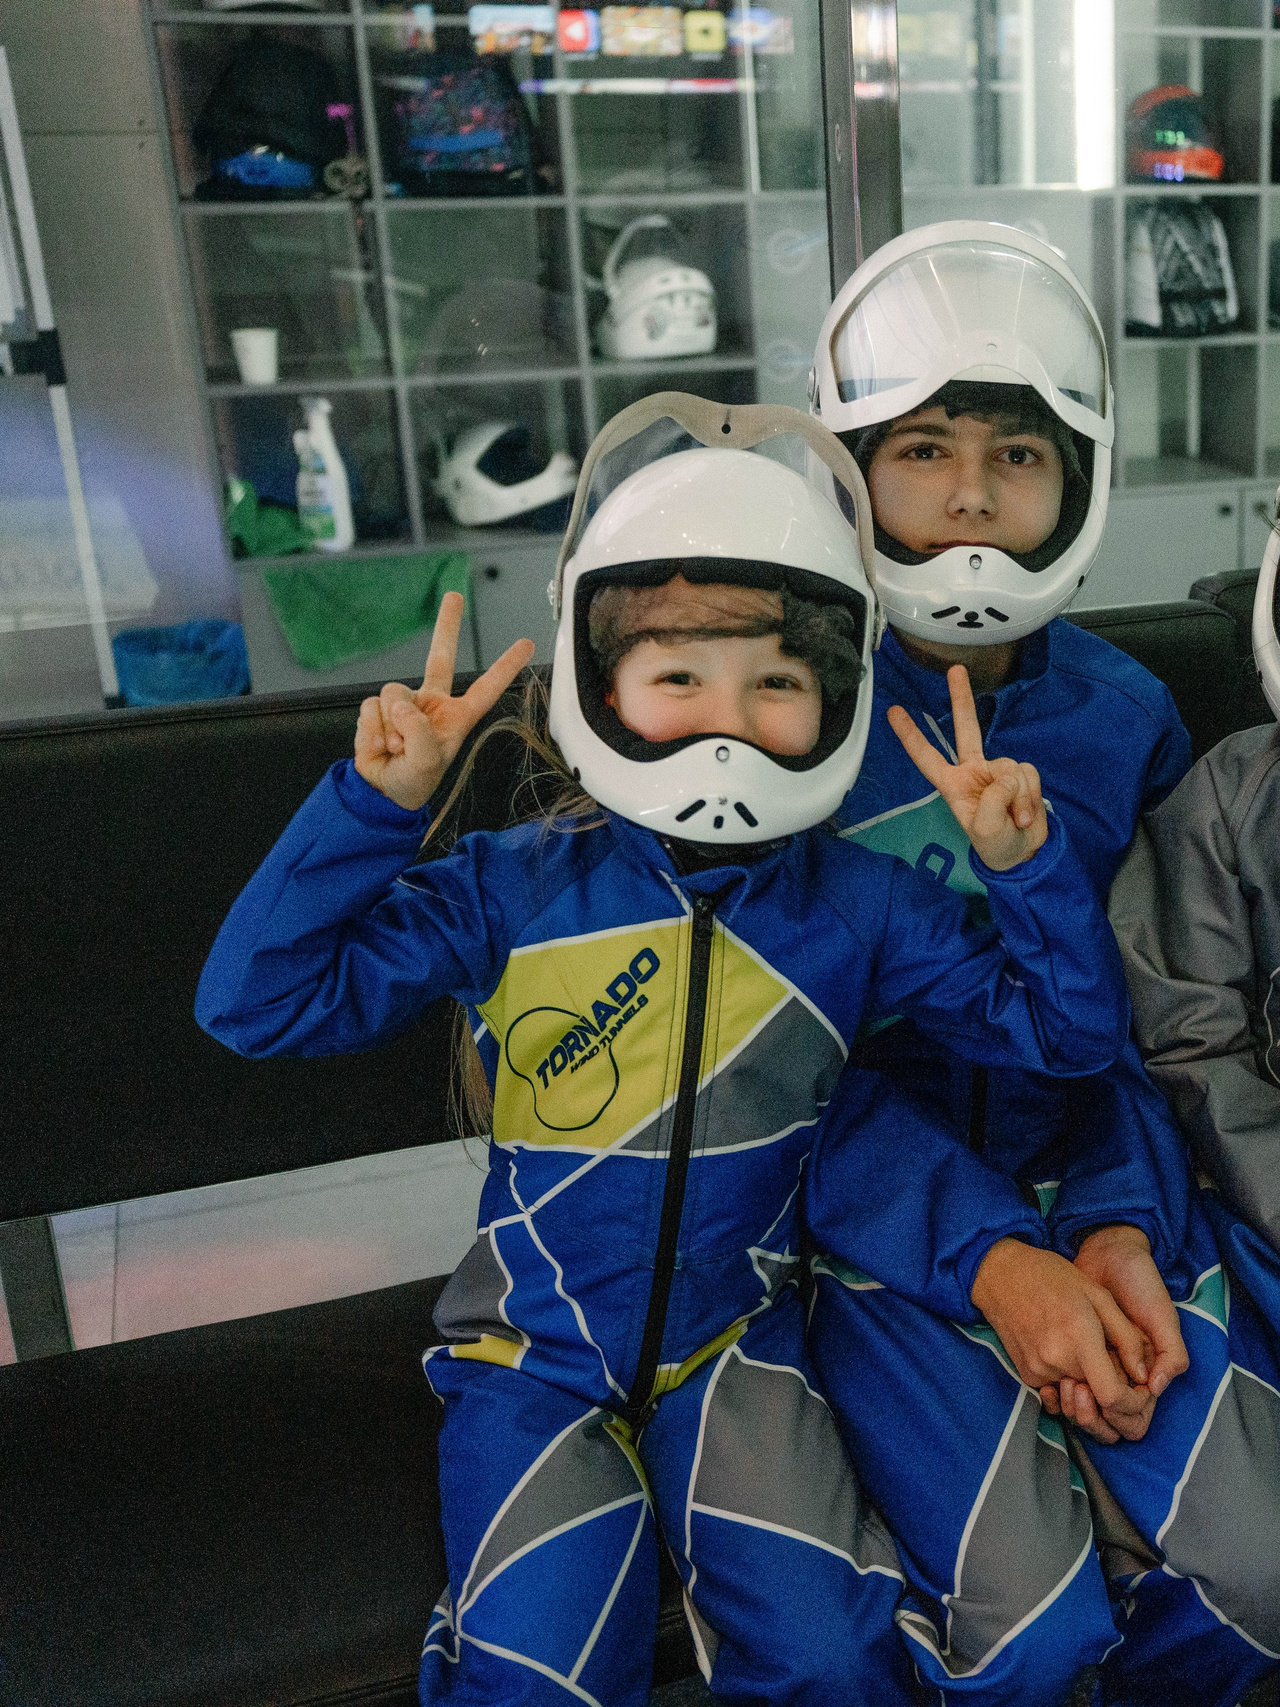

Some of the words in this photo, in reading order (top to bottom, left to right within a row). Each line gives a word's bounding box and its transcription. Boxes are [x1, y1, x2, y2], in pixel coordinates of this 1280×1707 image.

[535, 947, 660, 1090] TORNADO
[570, 1045, 600, 1075] WIND
[599, 994, 649, 1050] TUNNELS
